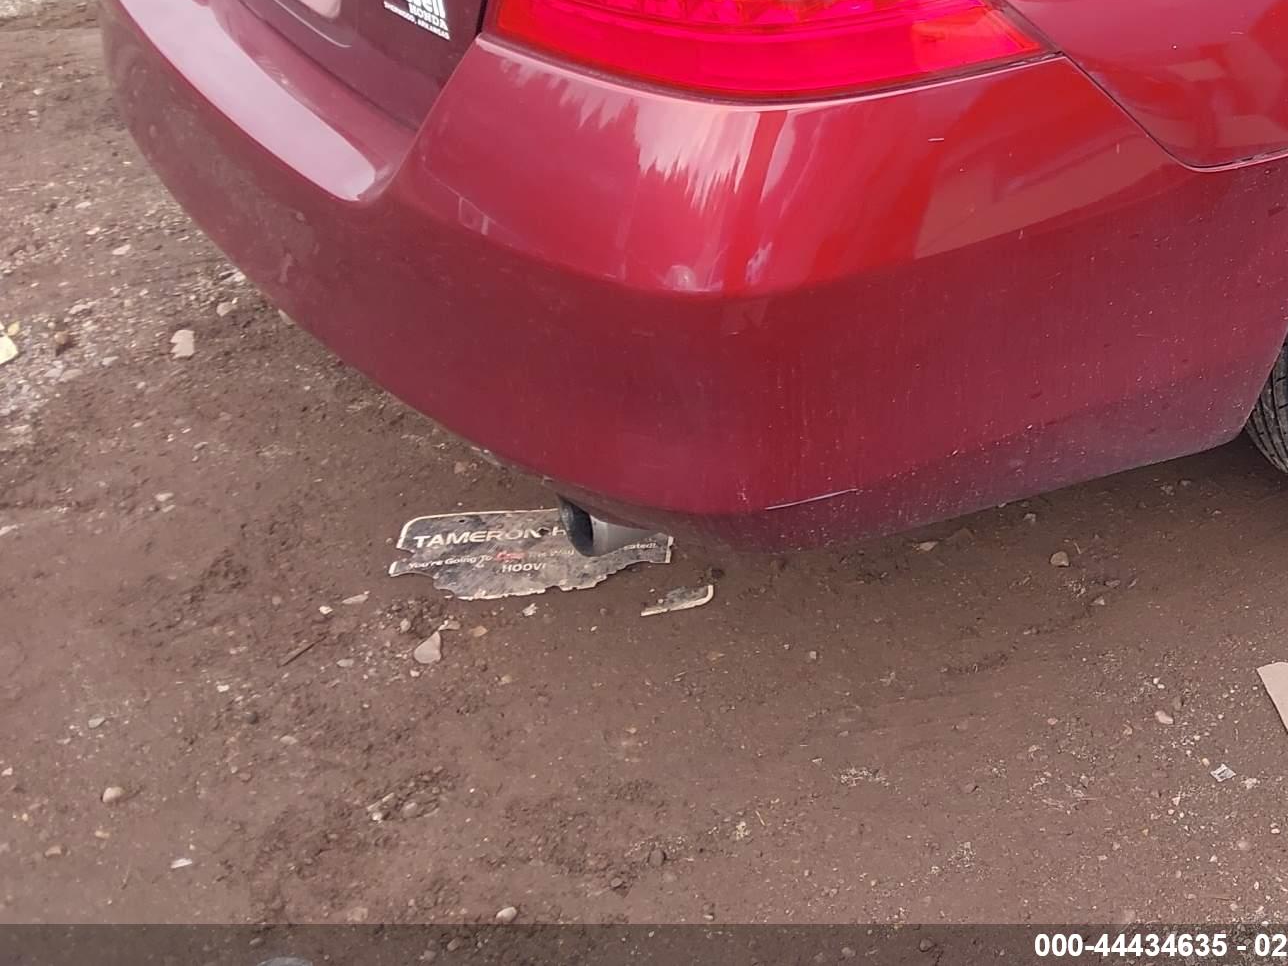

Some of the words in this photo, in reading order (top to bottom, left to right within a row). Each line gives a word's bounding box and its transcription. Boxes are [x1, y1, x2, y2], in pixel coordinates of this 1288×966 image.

[408, 2, 449, 32] HONDA
[412, 528, 543, 549] TAMERON
[444, 555, 477, 566] Going
